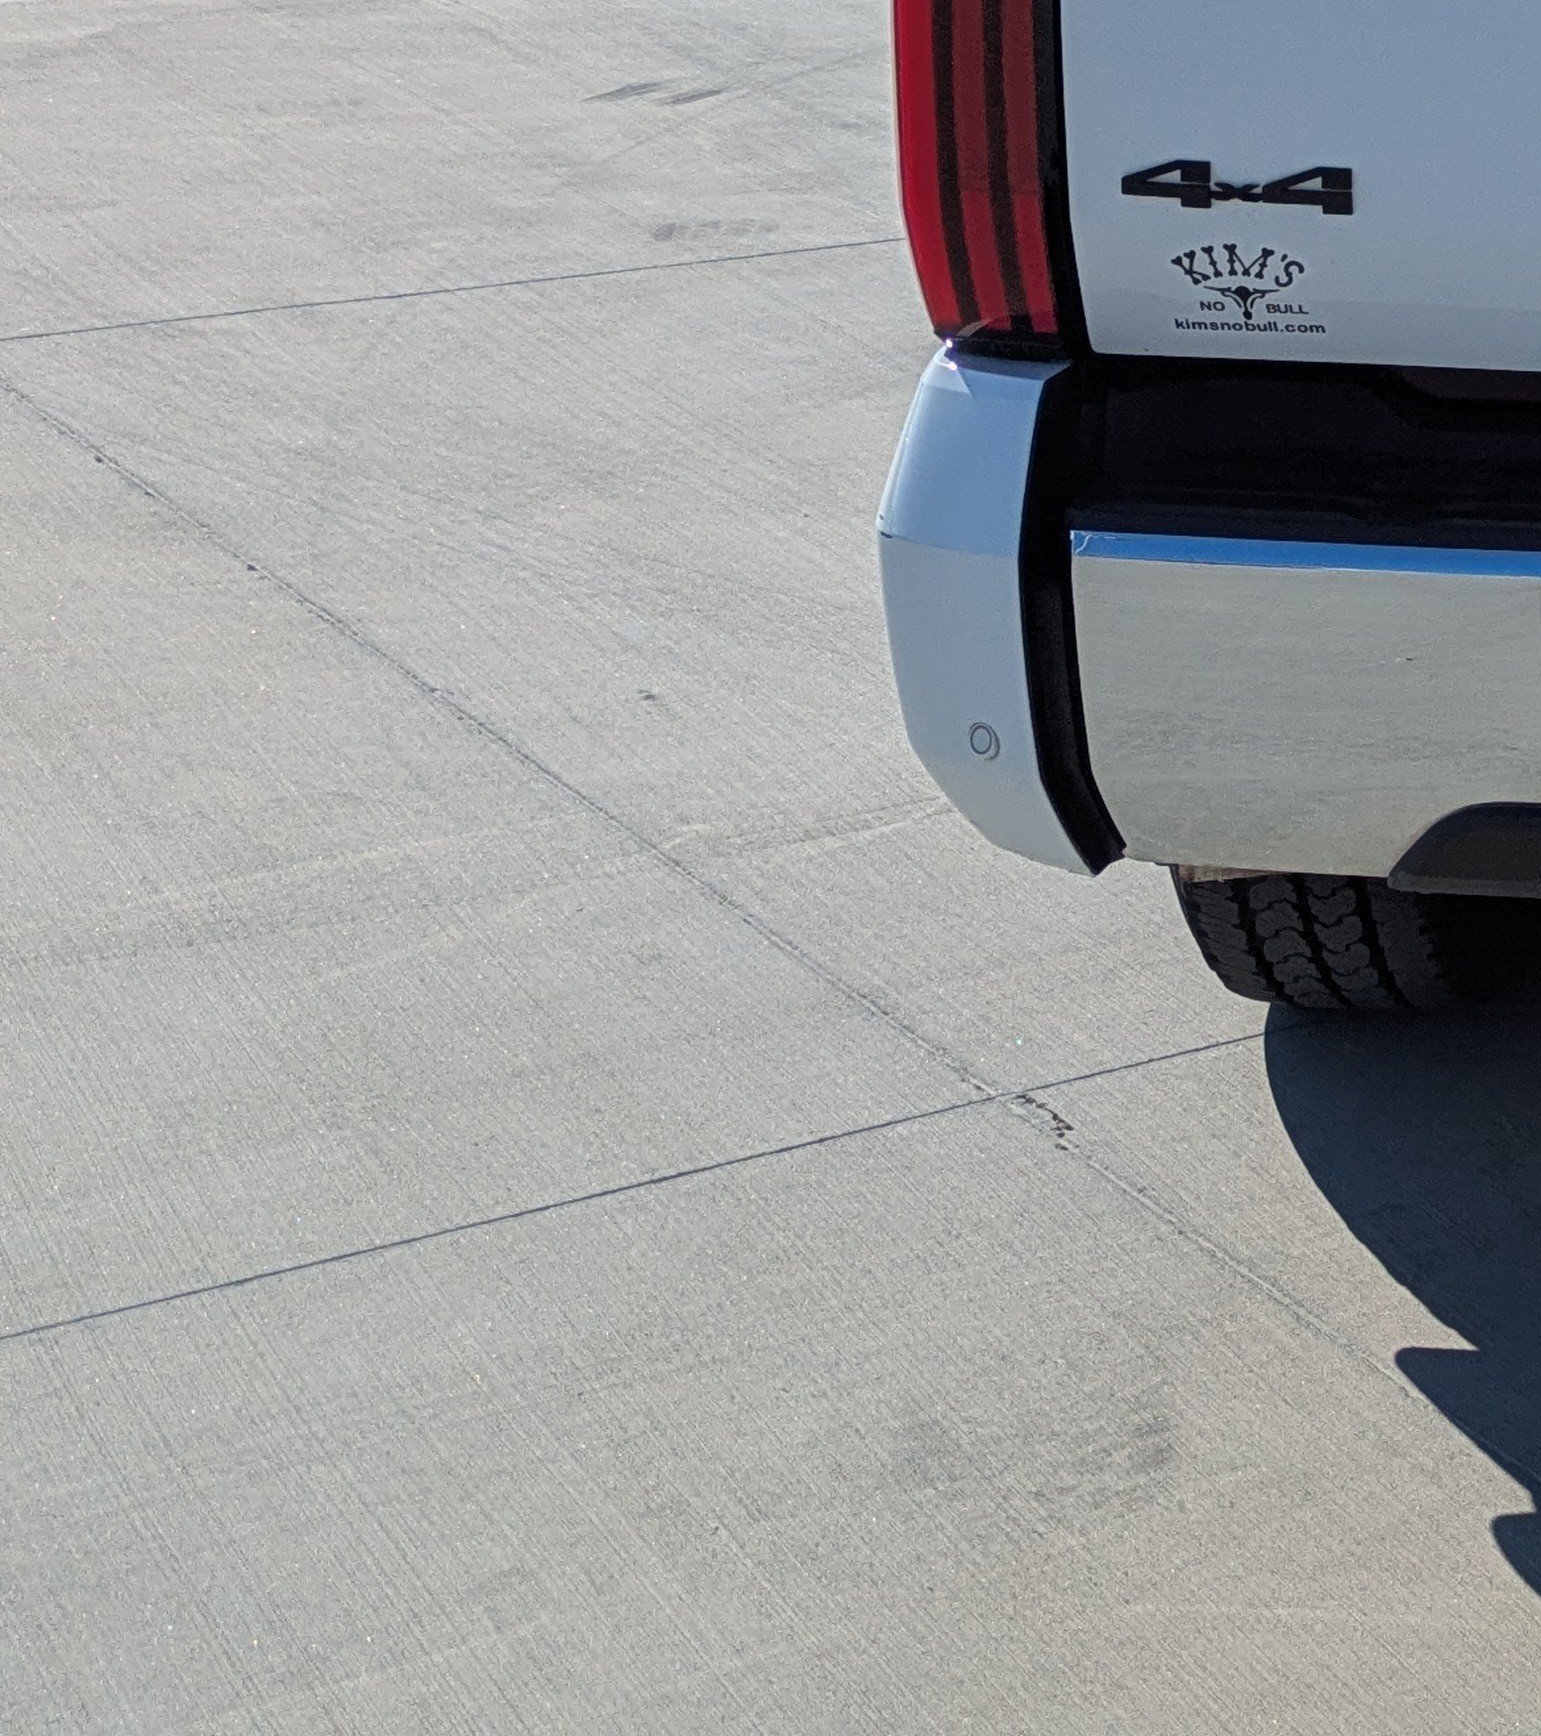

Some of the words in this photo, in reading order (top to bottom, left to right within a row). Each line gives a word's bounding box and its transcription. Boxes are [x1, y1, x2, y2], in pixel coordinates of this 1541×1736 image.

[1121, 159, 1353, 215] 4x4
[1171, 244, 1304, 286] KIM'S
[1200, 301, 1225, 312] NO
[1266, 304, 1309, 315] BULL
[1174, 319, 1326, 334] kimsnobull.com
